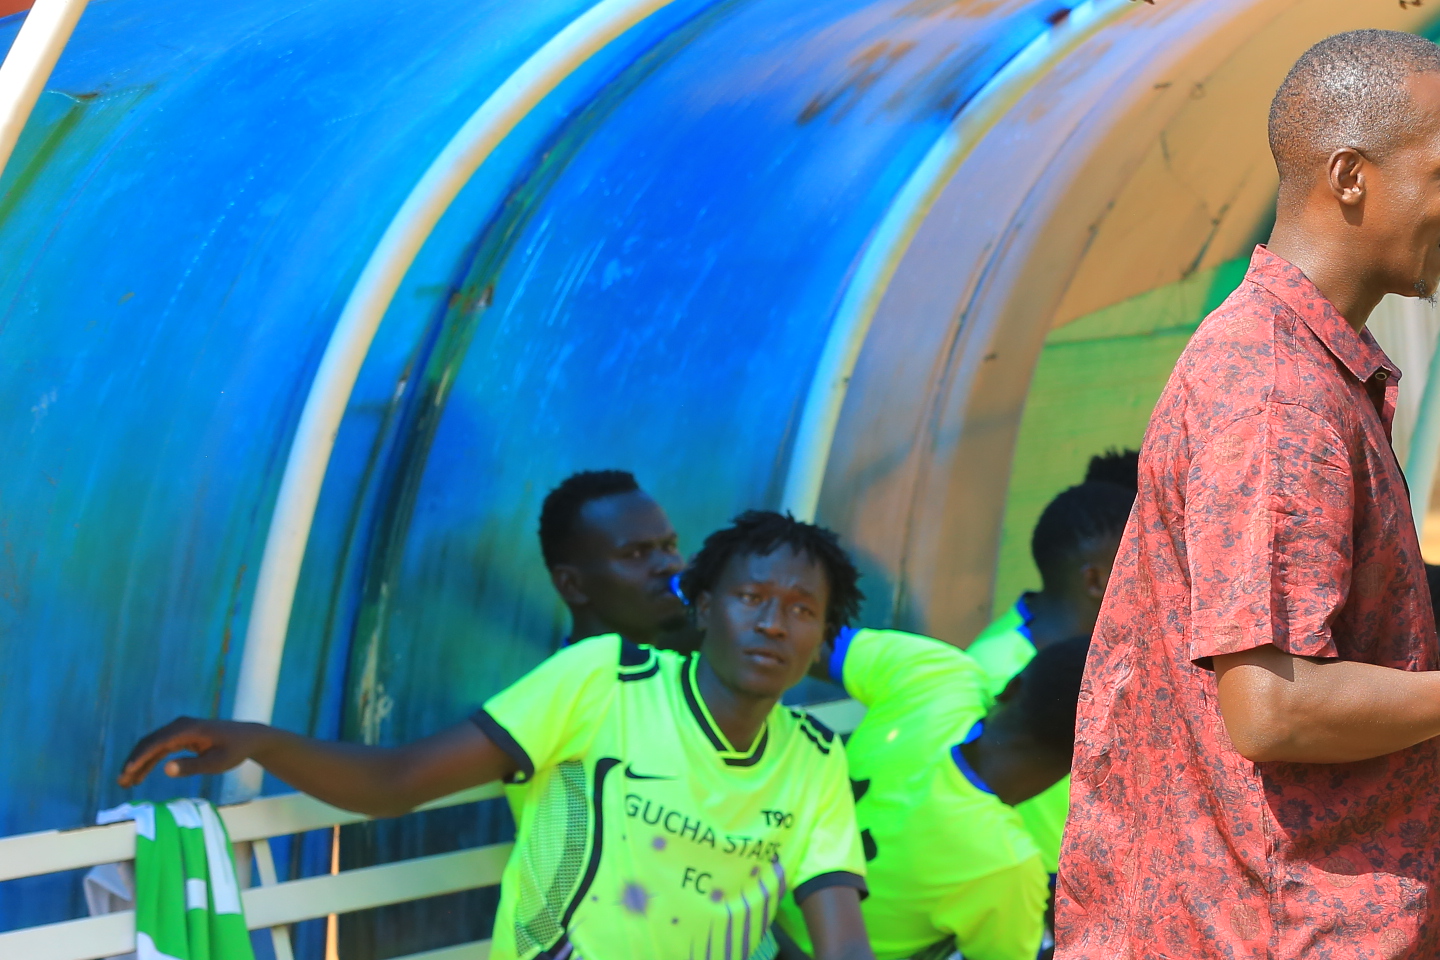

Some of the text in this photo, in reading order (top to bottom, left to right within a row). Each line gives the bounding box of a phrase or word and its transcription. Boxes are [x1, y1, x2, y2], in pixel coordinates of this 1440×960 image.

[625, 793, 716, 849] GUCHA
[761, 809, 794, 829] T90
[681, 867, 713, 894] FC
